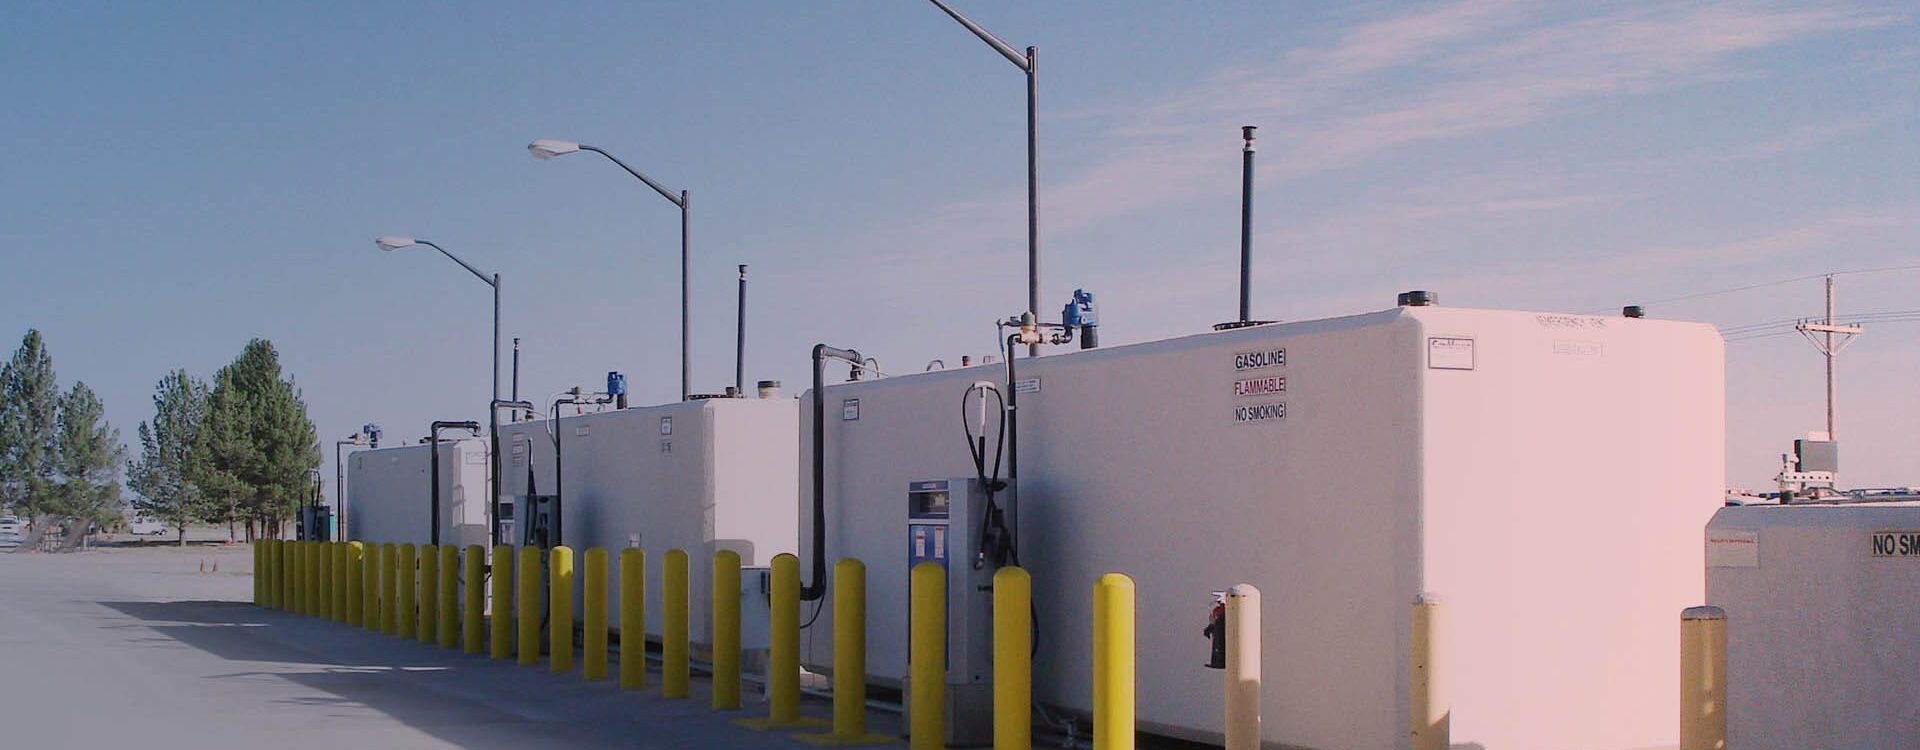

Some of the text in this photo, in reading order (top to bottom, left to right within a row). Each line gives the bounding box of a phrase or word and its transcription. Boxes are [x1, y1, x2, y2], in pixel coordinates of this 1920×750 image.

[1235, 350, 1283, 369] GASOLINE
[1235, 378, 1284, 395] FLAMMABLE
[1235, 403, 1283, 422] NO SMOKING
[1872, 534, 1895, 555] NO
